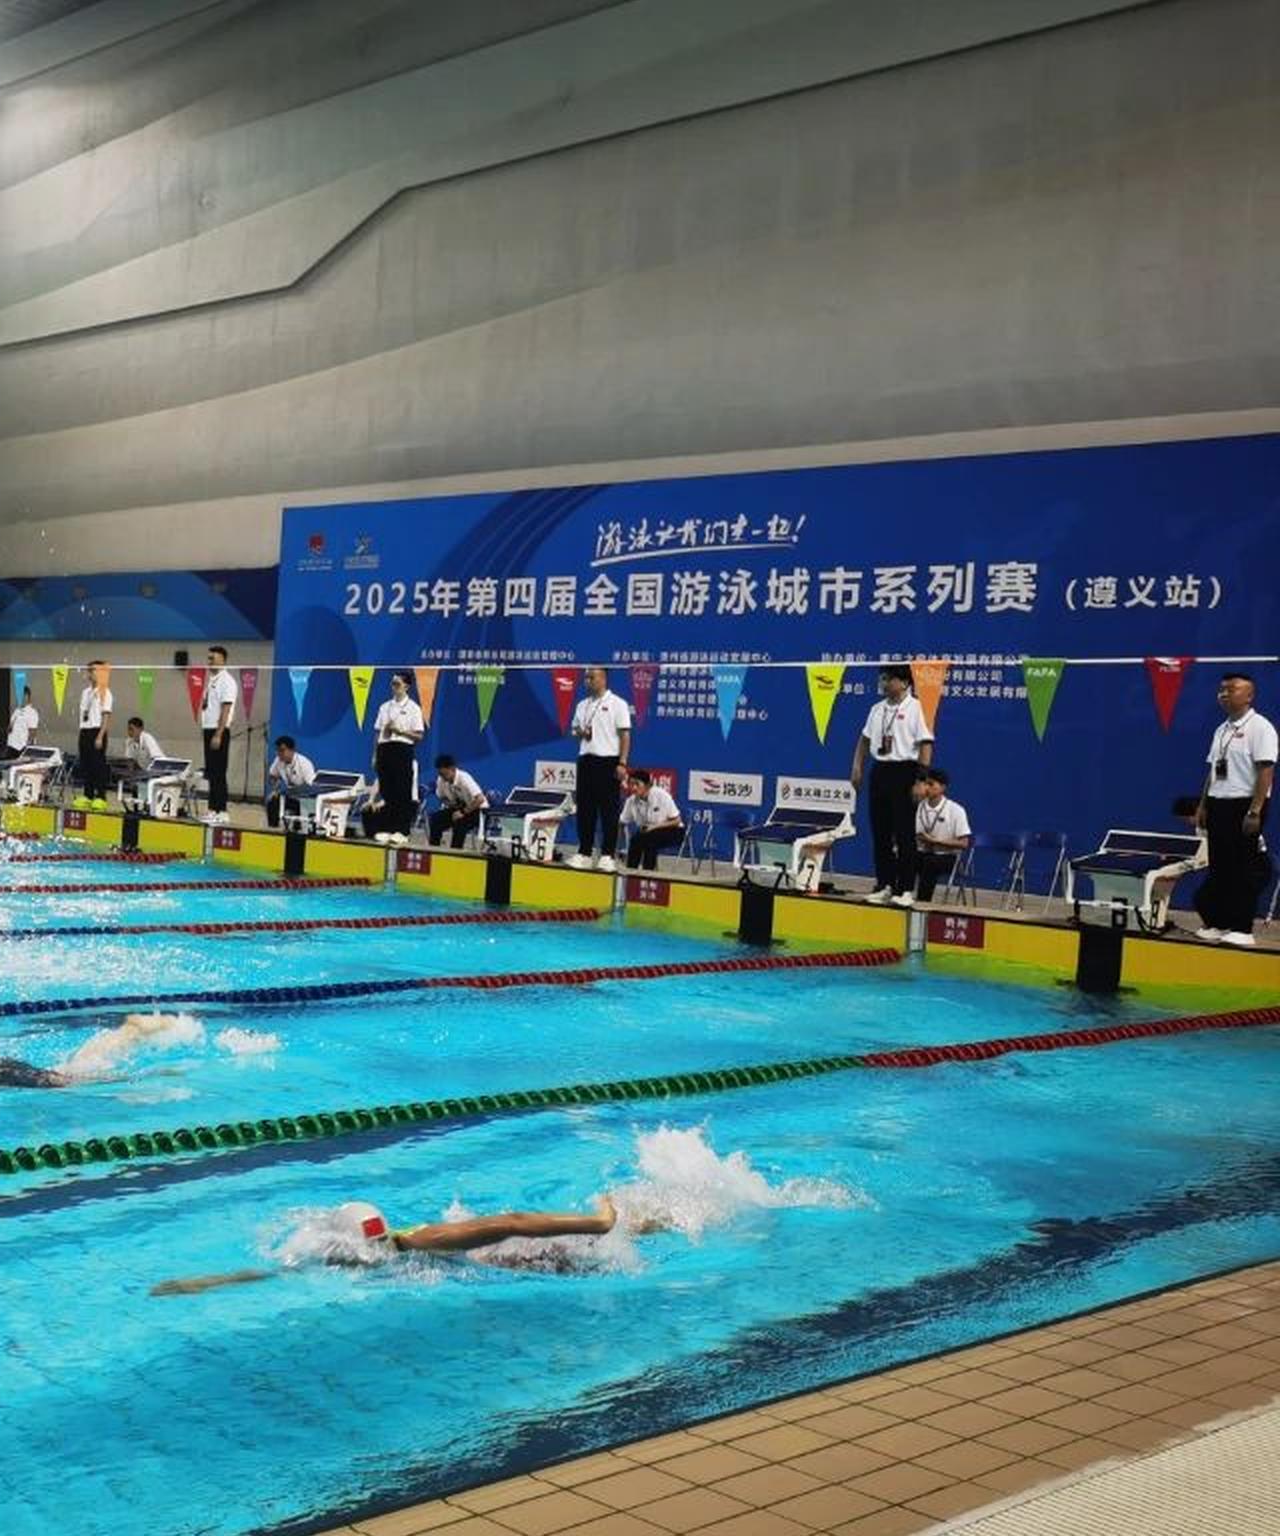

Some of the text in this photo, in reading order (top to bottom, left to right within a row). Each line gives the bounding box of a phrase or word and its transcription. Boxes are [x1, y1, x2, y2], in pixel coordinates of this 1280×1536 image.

[344, 561, 1038, 618] 2025年第四届全国游泳城市系列赛
[161, 797, 171, 816] 4
[330, 815, 339, 836] 5
[537, 836, 547, 861] 6
[805, 864, 815, 889] 7
